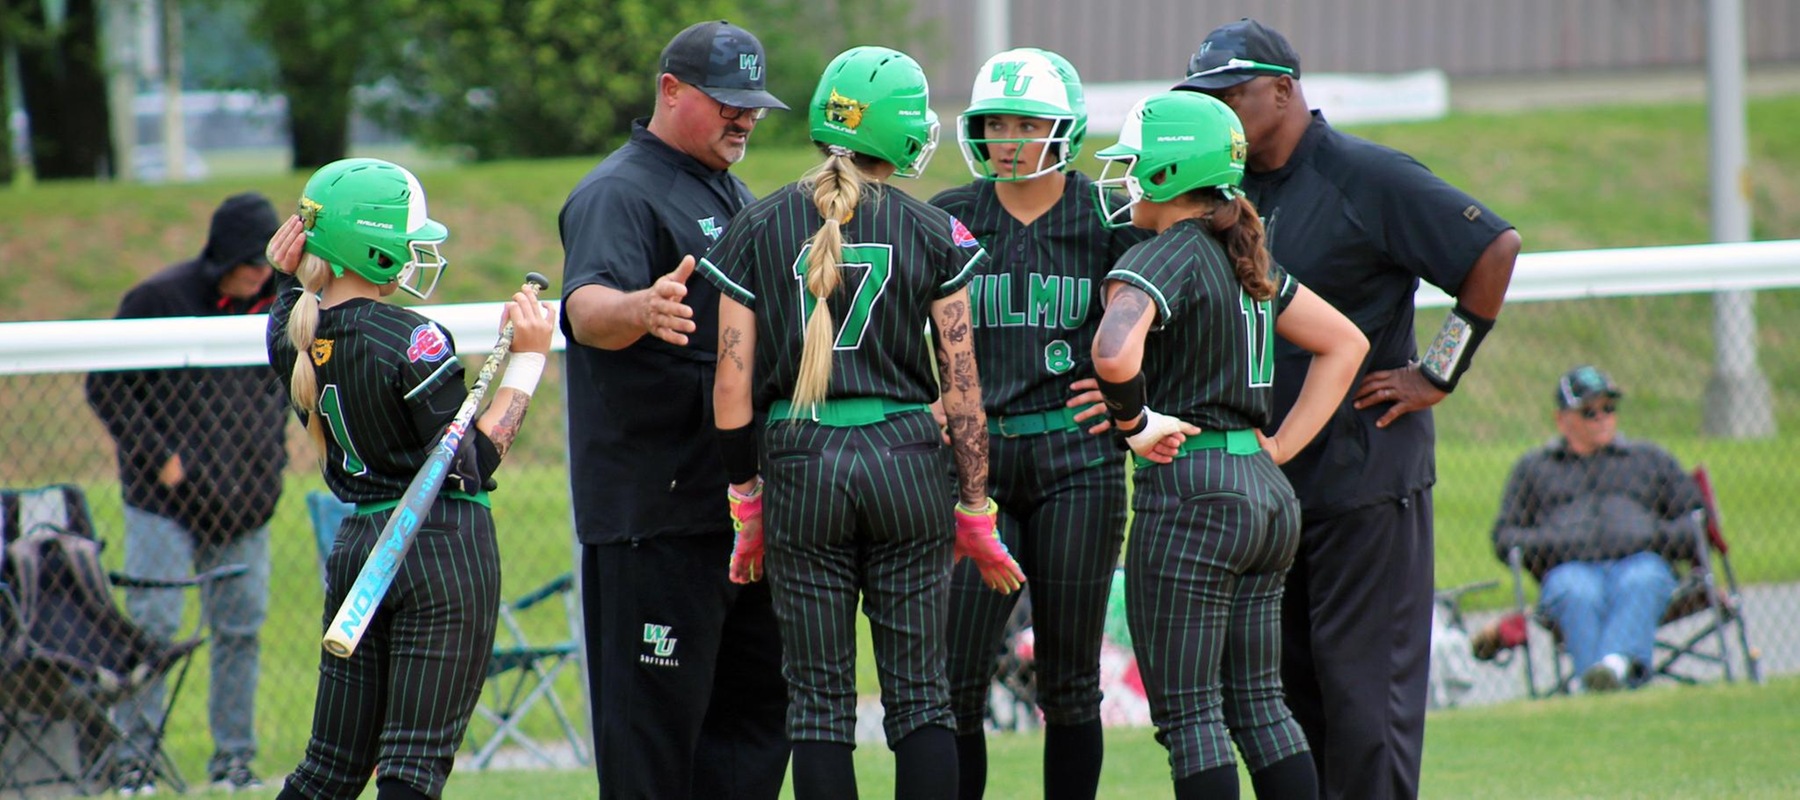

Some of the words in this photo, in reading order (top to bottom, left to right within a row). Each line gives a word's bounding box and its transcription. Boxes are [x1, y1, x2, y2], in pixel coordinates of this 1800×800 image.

[990, 61, 1034, 97] WU
[1045, 339, 1076, 376] 8
[1239, 285, 1274, 388] 11
[319, 384, 367, 477] 1
[340, 506, 418, 640] EASTON
[643, 623, 677, 657] WU
